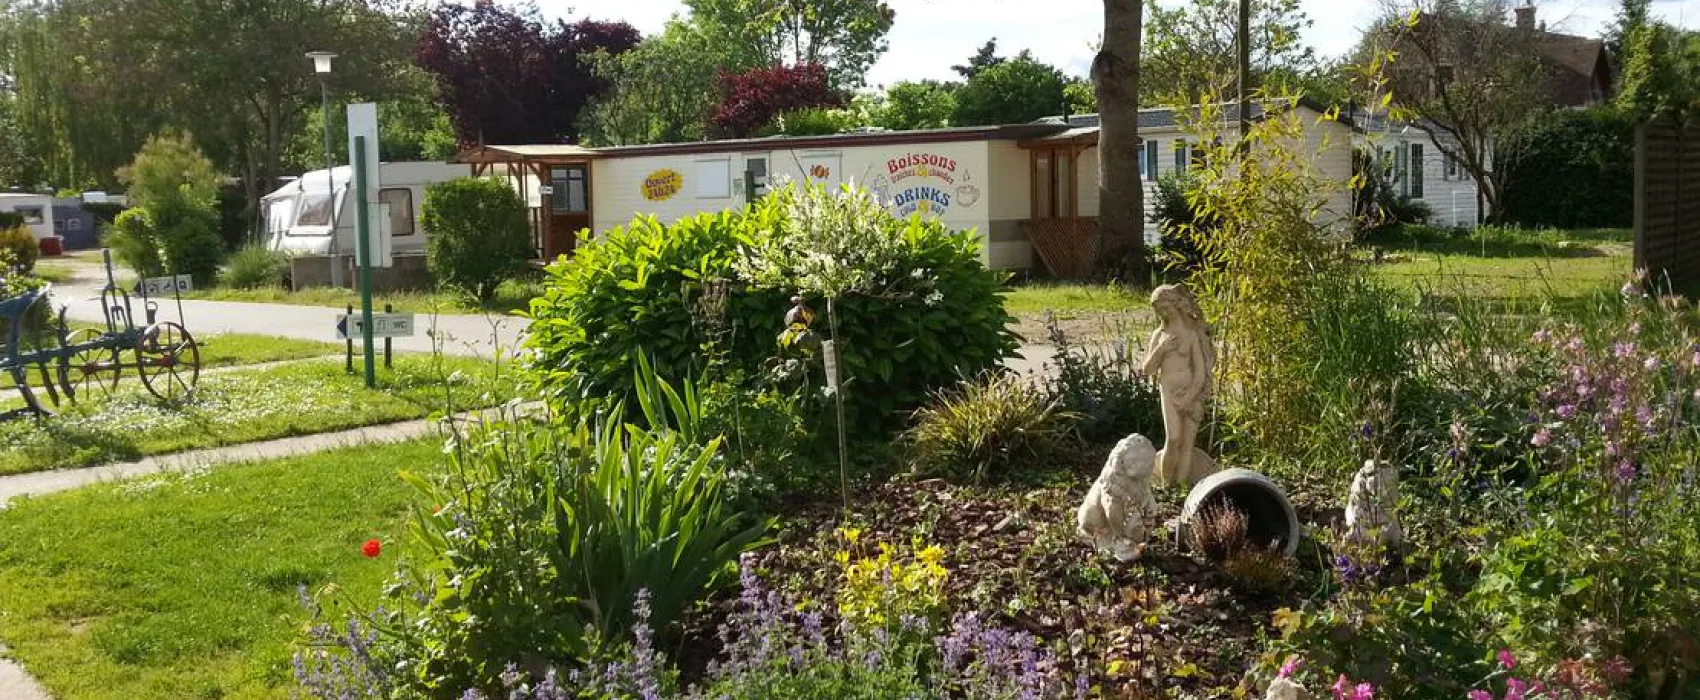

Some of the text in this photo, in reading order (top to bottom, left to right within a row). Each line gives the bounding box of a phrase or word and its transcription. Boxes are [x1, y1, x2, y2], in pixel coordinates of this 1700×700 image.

[887, 152, 956, 173] Boissons
[894, 187, 951, 207] DRINKS
[393, 320, 406, 329] WC
